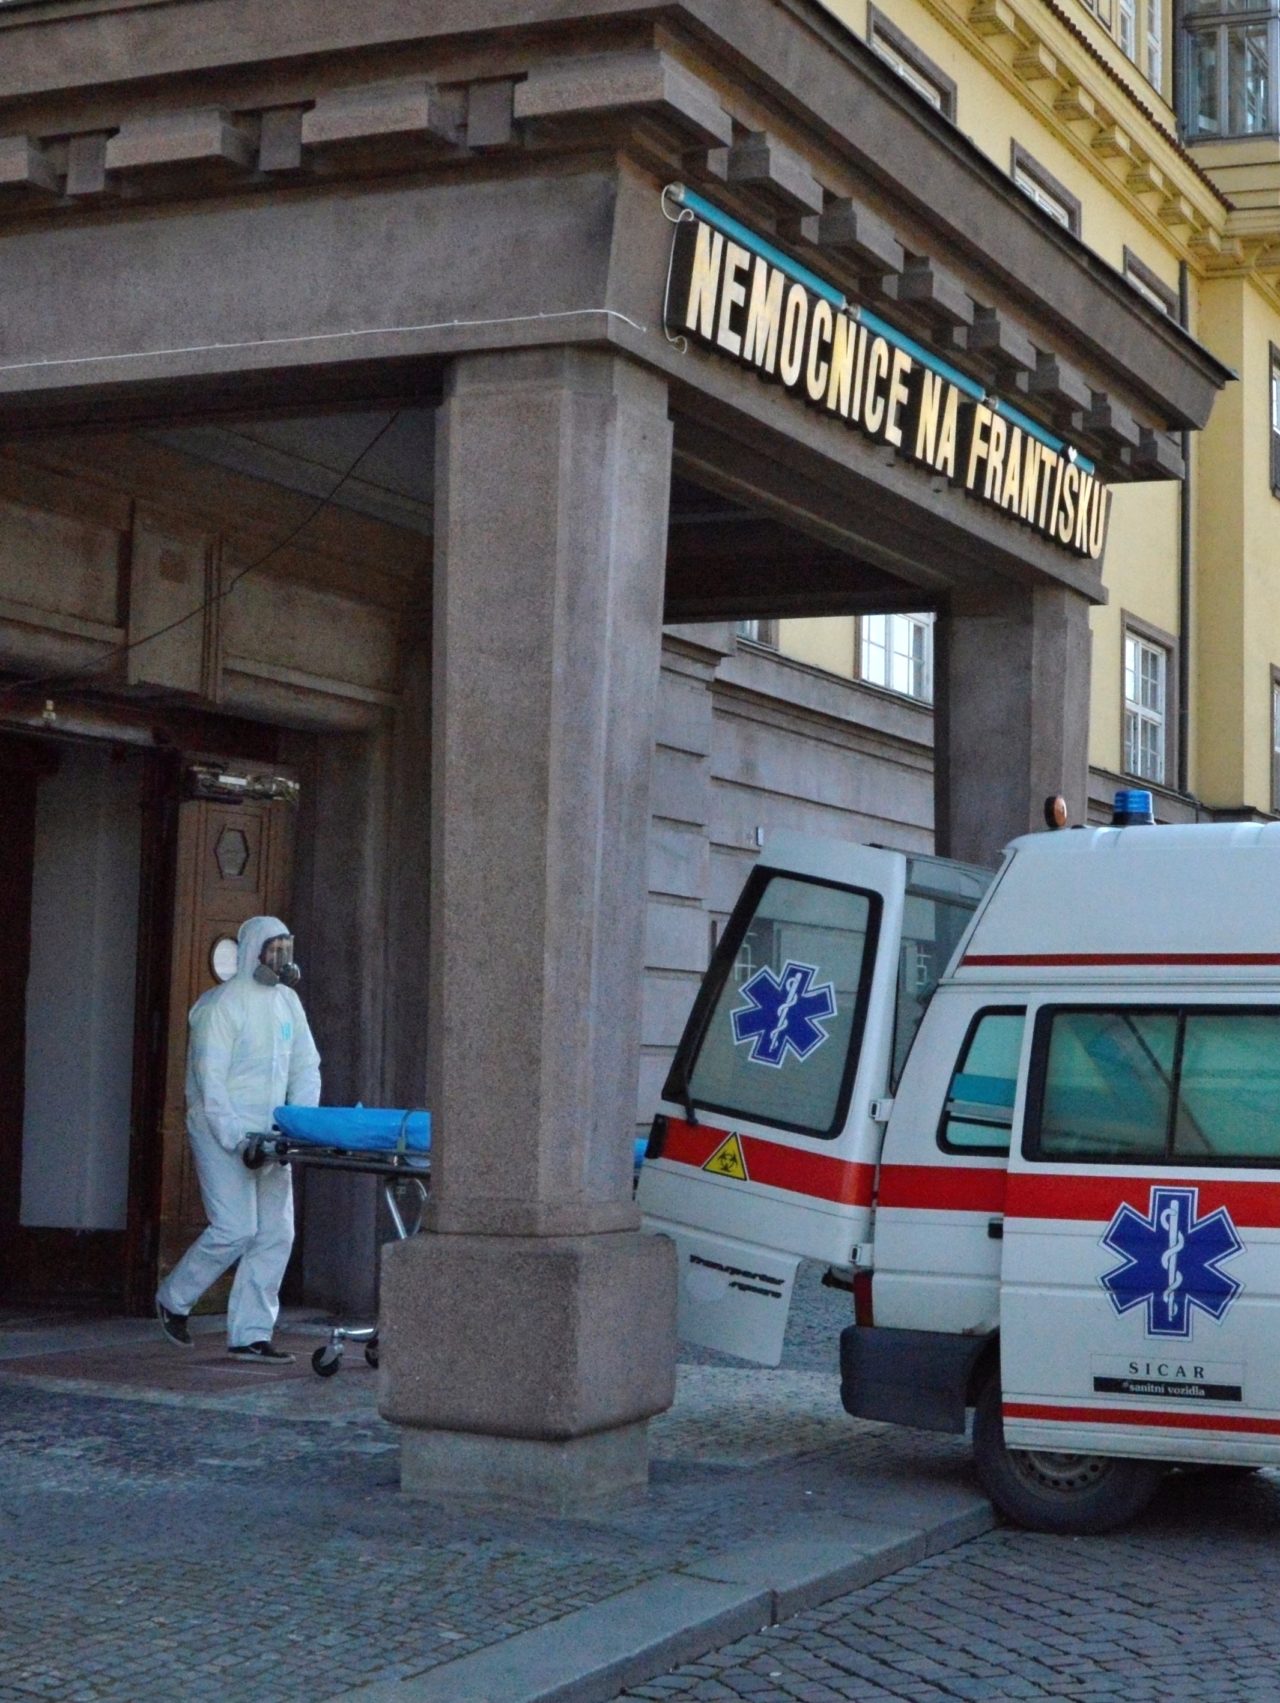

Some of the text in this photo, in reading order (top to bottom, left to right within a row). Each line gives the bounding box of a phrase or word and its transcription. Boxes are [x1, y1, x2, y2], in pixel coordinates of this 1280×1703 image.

[685, 221, 1108, 560] NEMOCNICE NA FRANTIŠKU
[1128, 1361, 1205, 1379] SICAR
[1167, 1384, 1206, 1397] vozidla
